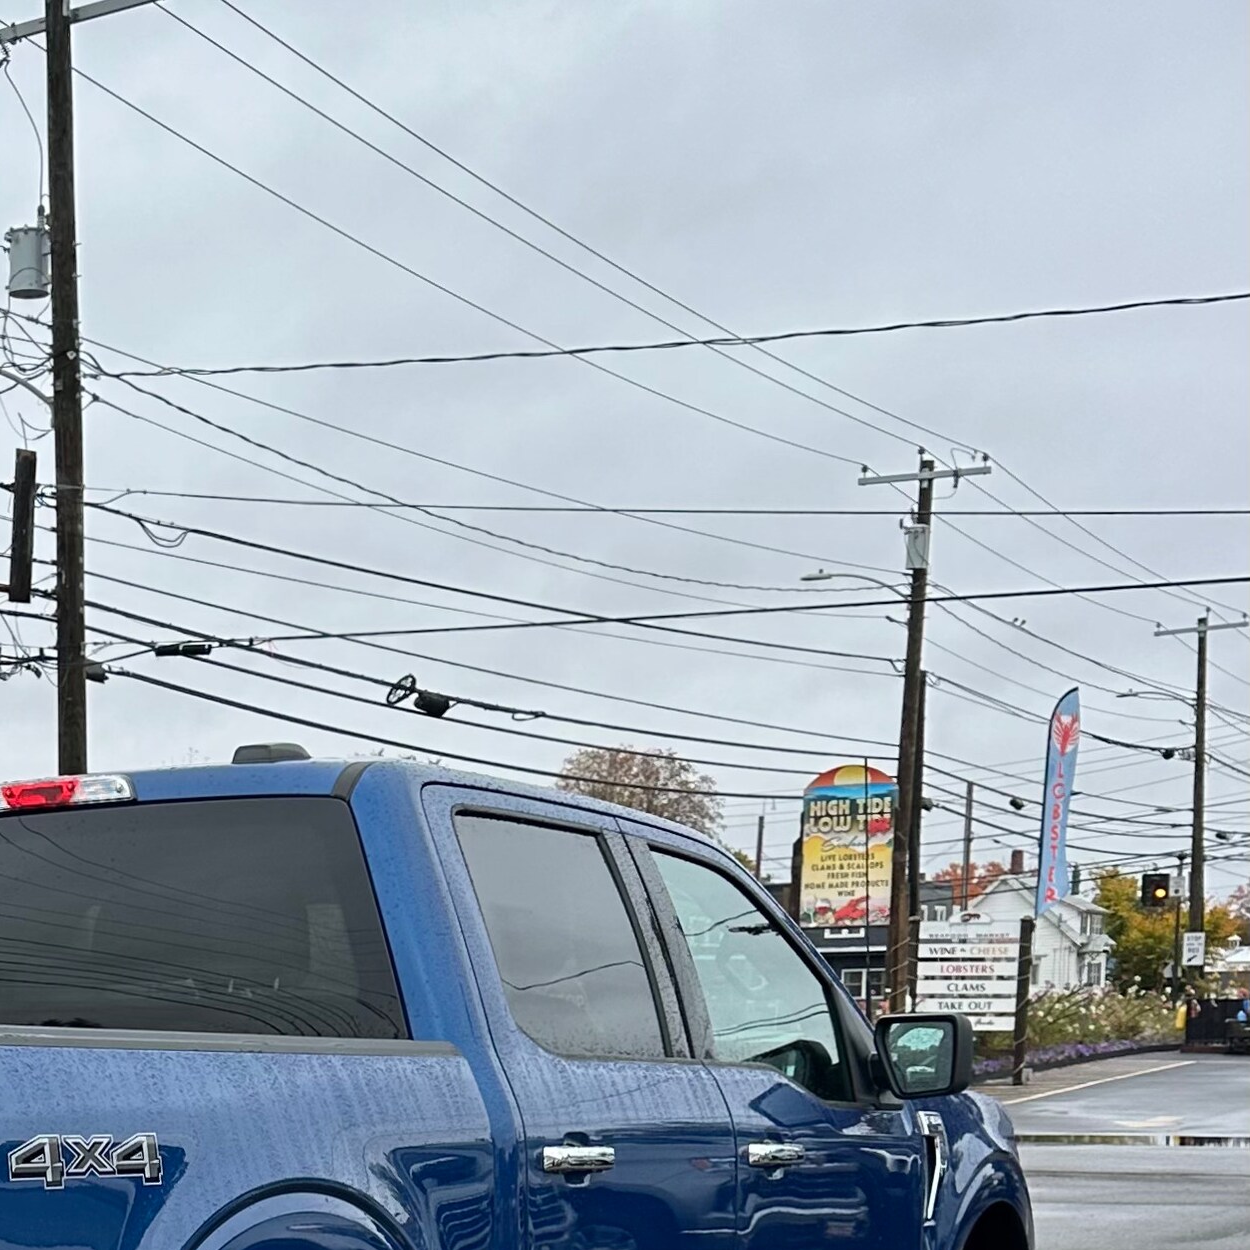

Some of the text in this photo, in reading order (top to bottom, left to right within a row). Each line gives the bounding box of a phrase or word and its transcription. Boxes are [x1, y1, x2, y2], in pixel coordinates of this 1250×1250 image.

[809, 797, 892, 817] HIGH TIDE
[809, 815, 851, 833] LOW
[820, 853, 875, 862] LIVE LOBSTES
[811, 864, 836, 872] CLAMS
[847, 861, 884, 870] SCALOPS
[929, 946, 957, 955] WINE
[970, 946, 1009, 955] CHEESE
[940, 964, 995, 974] LOBSTERS
[947, 983, 986, 992] CLAMS
[938, 1001, 993, 1010] TAKE OUT
